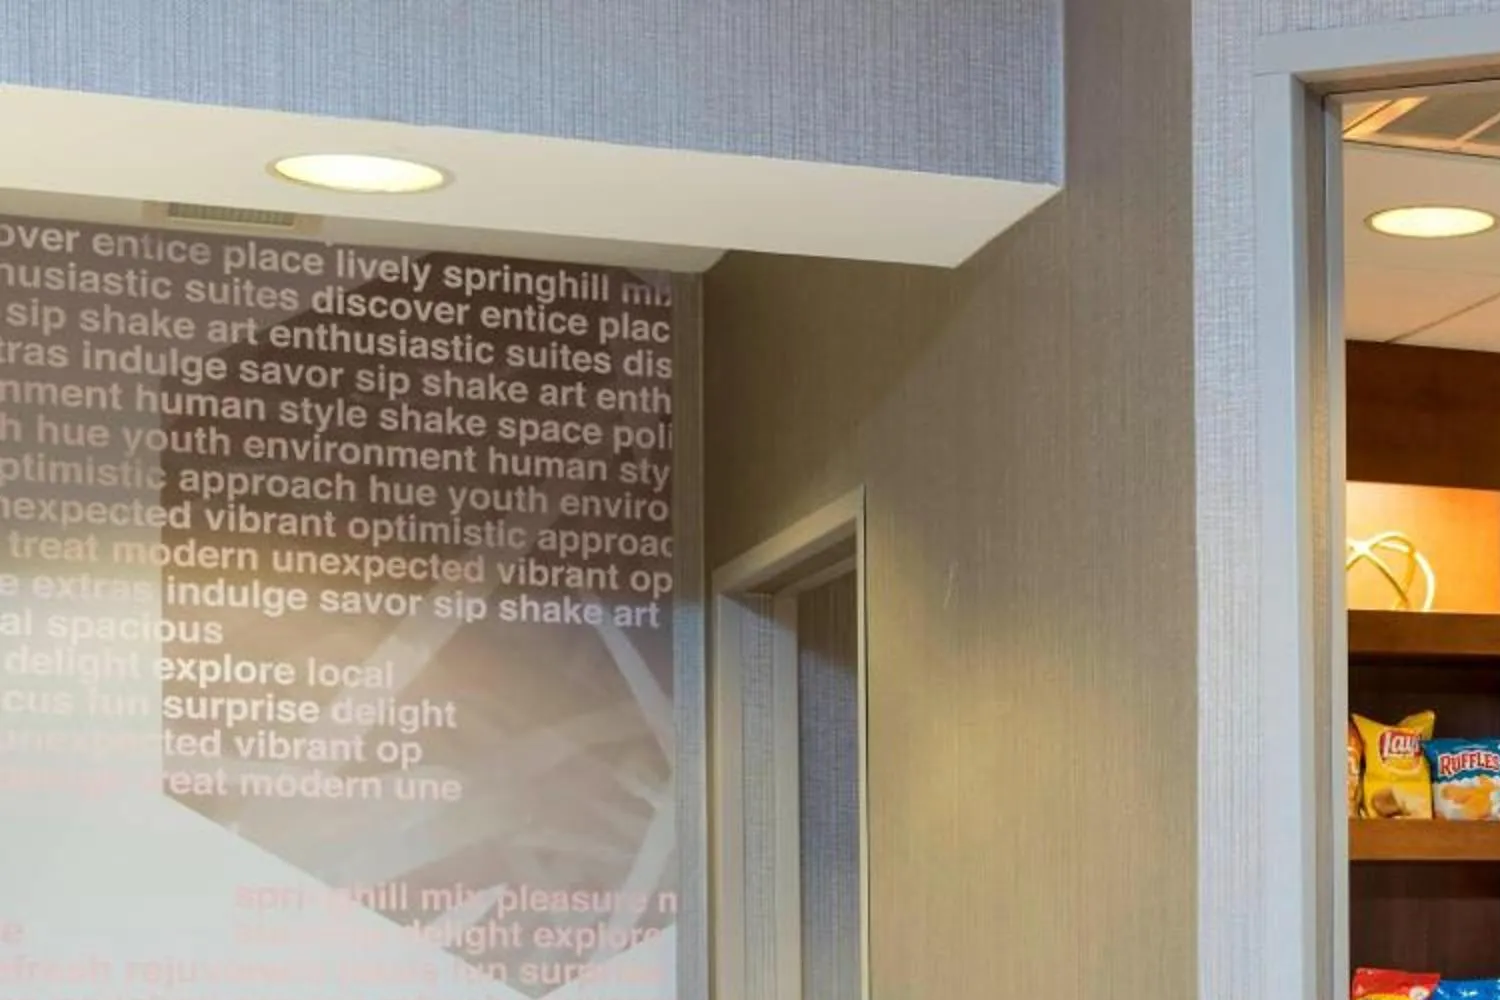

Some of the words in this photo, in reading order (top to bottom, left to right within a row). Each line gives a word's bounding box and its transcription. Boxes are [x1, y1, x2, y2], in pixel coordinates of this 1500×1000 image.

[92, 230, 212, 266] entice
[223, 241, 323, 275] place
[336, 248, 431, 293] lively
[443, 264, 610, 304] springhill
[5, 297, 67, 336] sip
[79, 303, 196, 340] shake
[207, 317, 258, 346] art
[269, 322, 495, 365] enthusiastic
[505, 342, 612, 375] suites
[622, 349, 673, 379] dis
[184, 276, 299, 311] suites
[311, 286, 471, 326] discover
[480, 304, 590, 336] entice
[598, 311, 671, 345] plac
[83, 340, 227, 385] indulge
[239, 358, 344, 389] savor
[355, 364, 411, 399] sip
[421, 369, 529, 403] shake
[538, 381, 588, 408] art
[596, 385, 672, 414] enth
[135, 383, 266, 420] human
[279, 398, 368, 432] style
[378, 402, 487, 437] shake
[497, 416, 601, 447] space
[37, 414, 110, 448] hue
[122, 422, 231, 456] youth
[243, 433, 478, 474] environment
[487, 446, 607, 482] human
[619, 458, 670, 493] sty
[179, 468, 356, 502] approach
[369, 474, 438, 507] hue
[448, 484, 549, 515] youth
[560, 491, 669, 521] enviro
[204, 503, 337, 538] vibrant
[348, 514, 527, 547] optimistic
[537, 526, 673, 560] approac
[10, 530, 99, 562] treat
[112, 538, 259, 570] modern
[272, 547, 485, 584] unexpected
[497, 557, 619, 591] vibrant
[629, 569, 673, 599] op
[47, 607, 224, 645] spacious
[166, 575, 308, 618] indulge
[319, 590, 424, 617] savor
[433, 589, 488, 623] sip
[498, 593, 604, 625] shake
[613, 601, 661, 629] art
[4, 644, 143, 684] delight
[152, 653, 296, 688] explore
[308, 657, 394, 690] local
[163, 693, 321, 728] surprise
[331, 694, 458, 733] delight
[233, 730, 367, 763] vibrant
[376, 739, 423, 769] op
[240, 768, 382, 801] modern
[394, 775, 464, 803] une
[497, 882, 649, 919] pleasure
